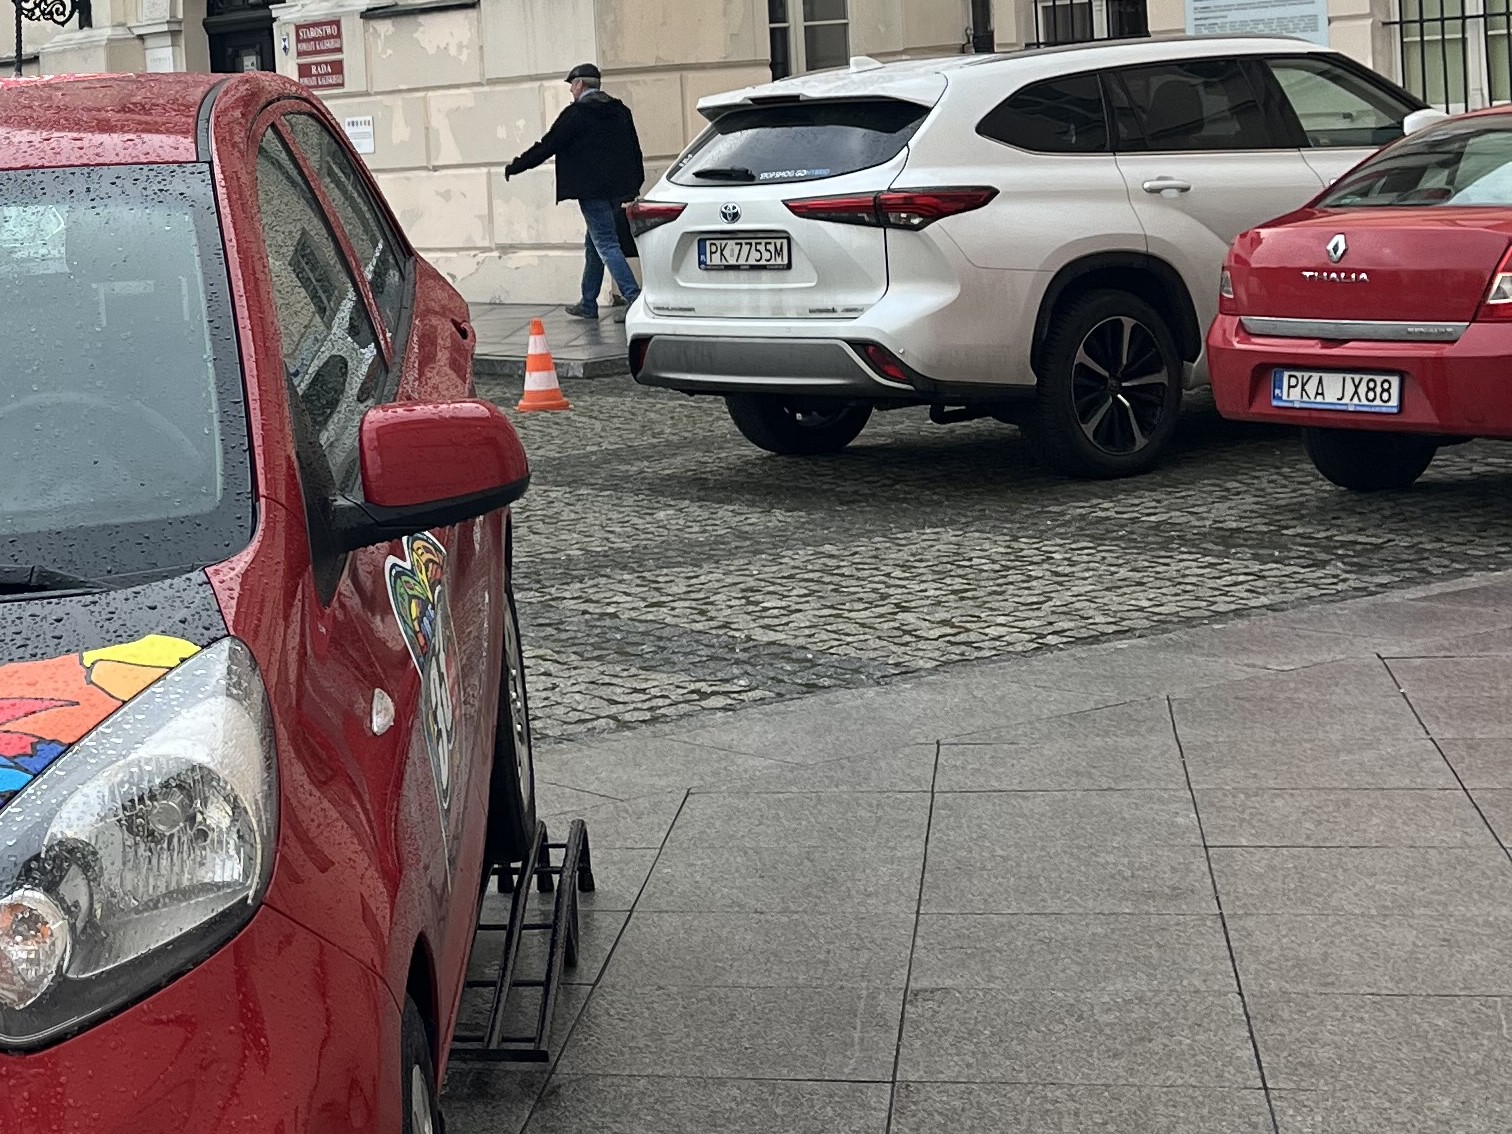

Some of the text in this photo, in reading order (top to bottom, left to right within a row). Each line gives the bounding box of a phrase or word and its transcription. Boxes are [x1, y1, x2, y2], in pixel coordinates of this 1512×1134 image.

[299, 25, 337, 40] STAROSTWO
[311, 64, 331, 75] RADA
[709, 241, 784, 263] PK 7755M
[1301, 271, 1370, 283] THALIA
[1287, 374, 1392, 404] PKA JX88
